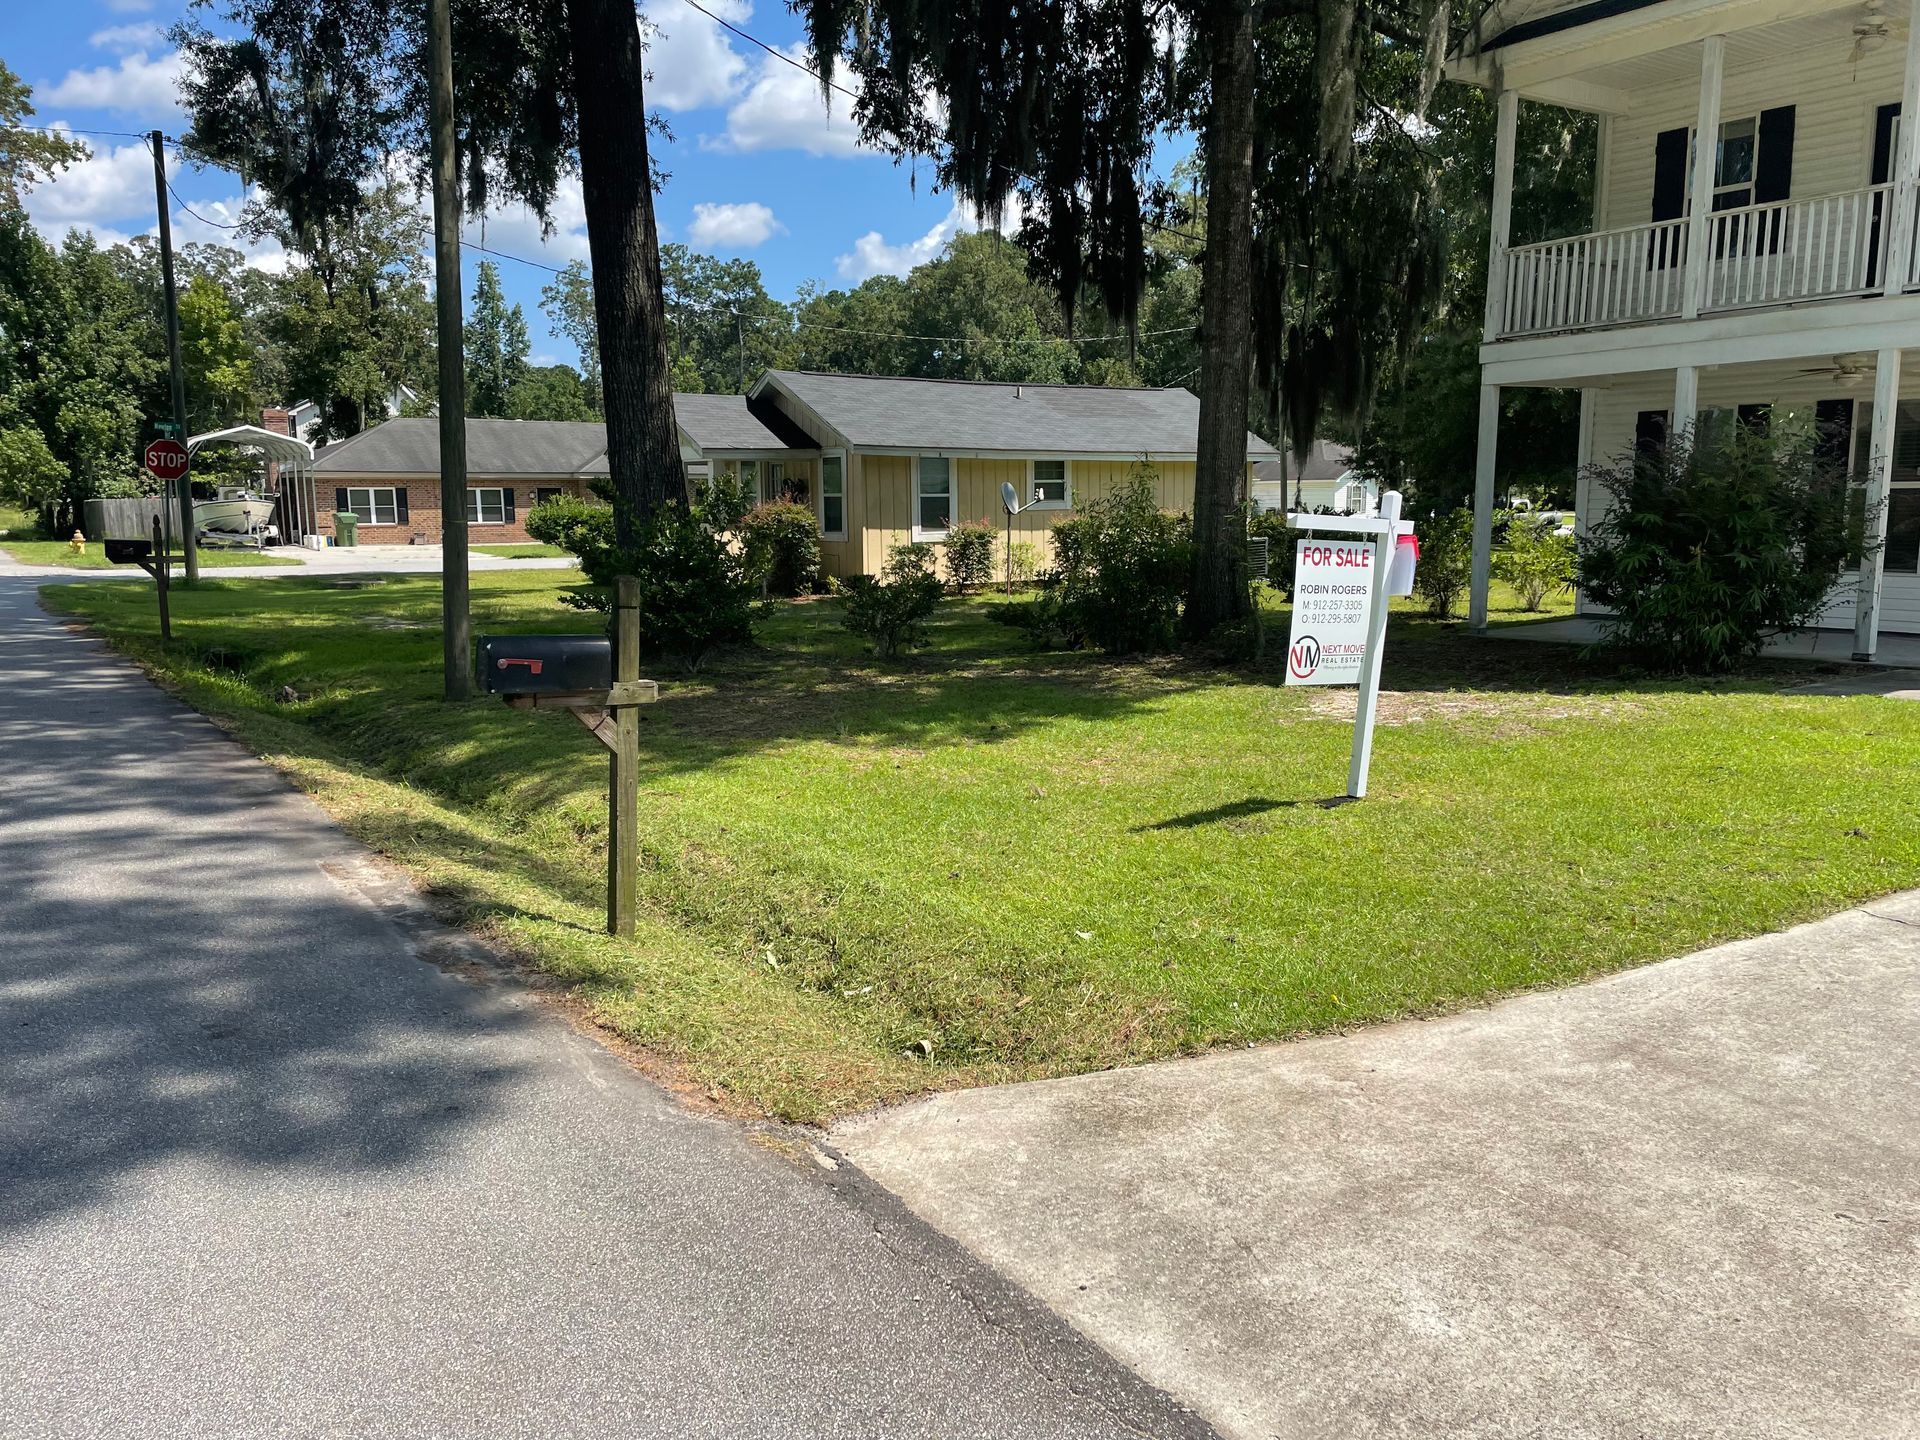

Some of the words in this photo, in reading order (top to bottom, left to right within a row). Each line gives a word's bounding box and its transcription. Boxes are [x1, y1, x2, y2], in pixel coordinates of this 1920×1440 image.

[149, 452, 186, 467] STOP
[1303, 547, 1331, 566] FOR
[1336, 548, 1369, 567] SALE
[1300, 584, 1329, 594] ROBIN
[1331, 585, 1367, 595] ROGERS
[1302, 600, 1311, 610] M:
[1313, 600, 1363, 611] 912-257-3305
[1301, 614, 1310, 624] O:
[1312, 613, 1361, 623] 912-295-5807
[1322, 645, 1342, 654] NEXT
[1344, 645, 1365, 653] MOVE
